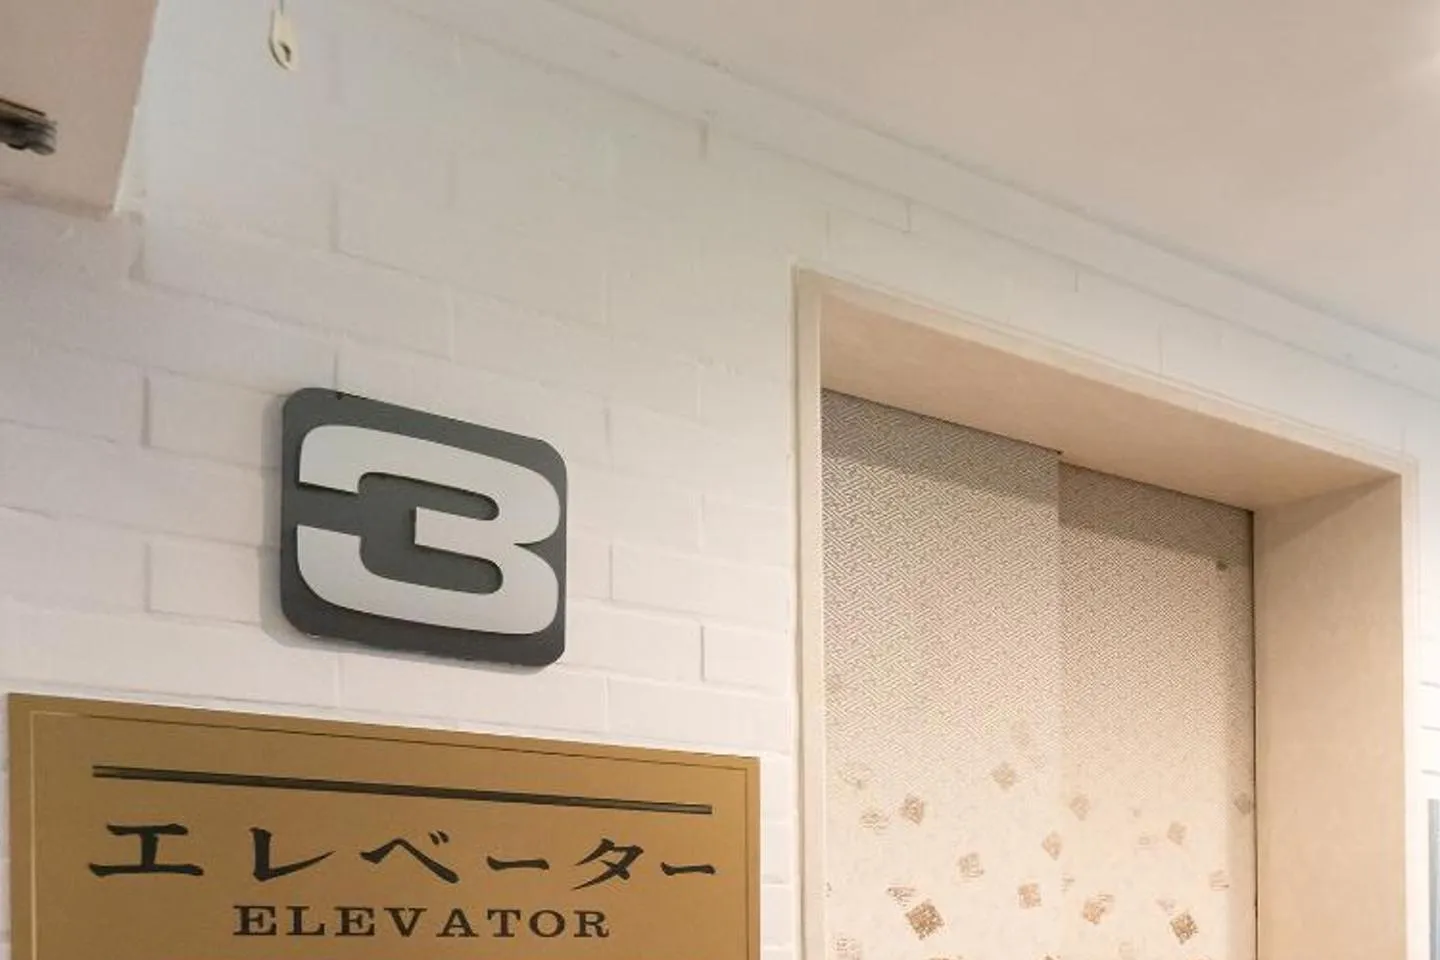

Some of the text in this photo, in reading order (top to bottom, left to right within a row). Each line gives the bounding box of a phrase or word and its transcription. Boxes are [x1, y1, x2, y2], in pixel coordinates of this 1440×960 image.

[297, 424, 561, 635] 3
[87, 823, 717, 890] エレベーター
[232, 904, 612, 939] ELEVATOR
